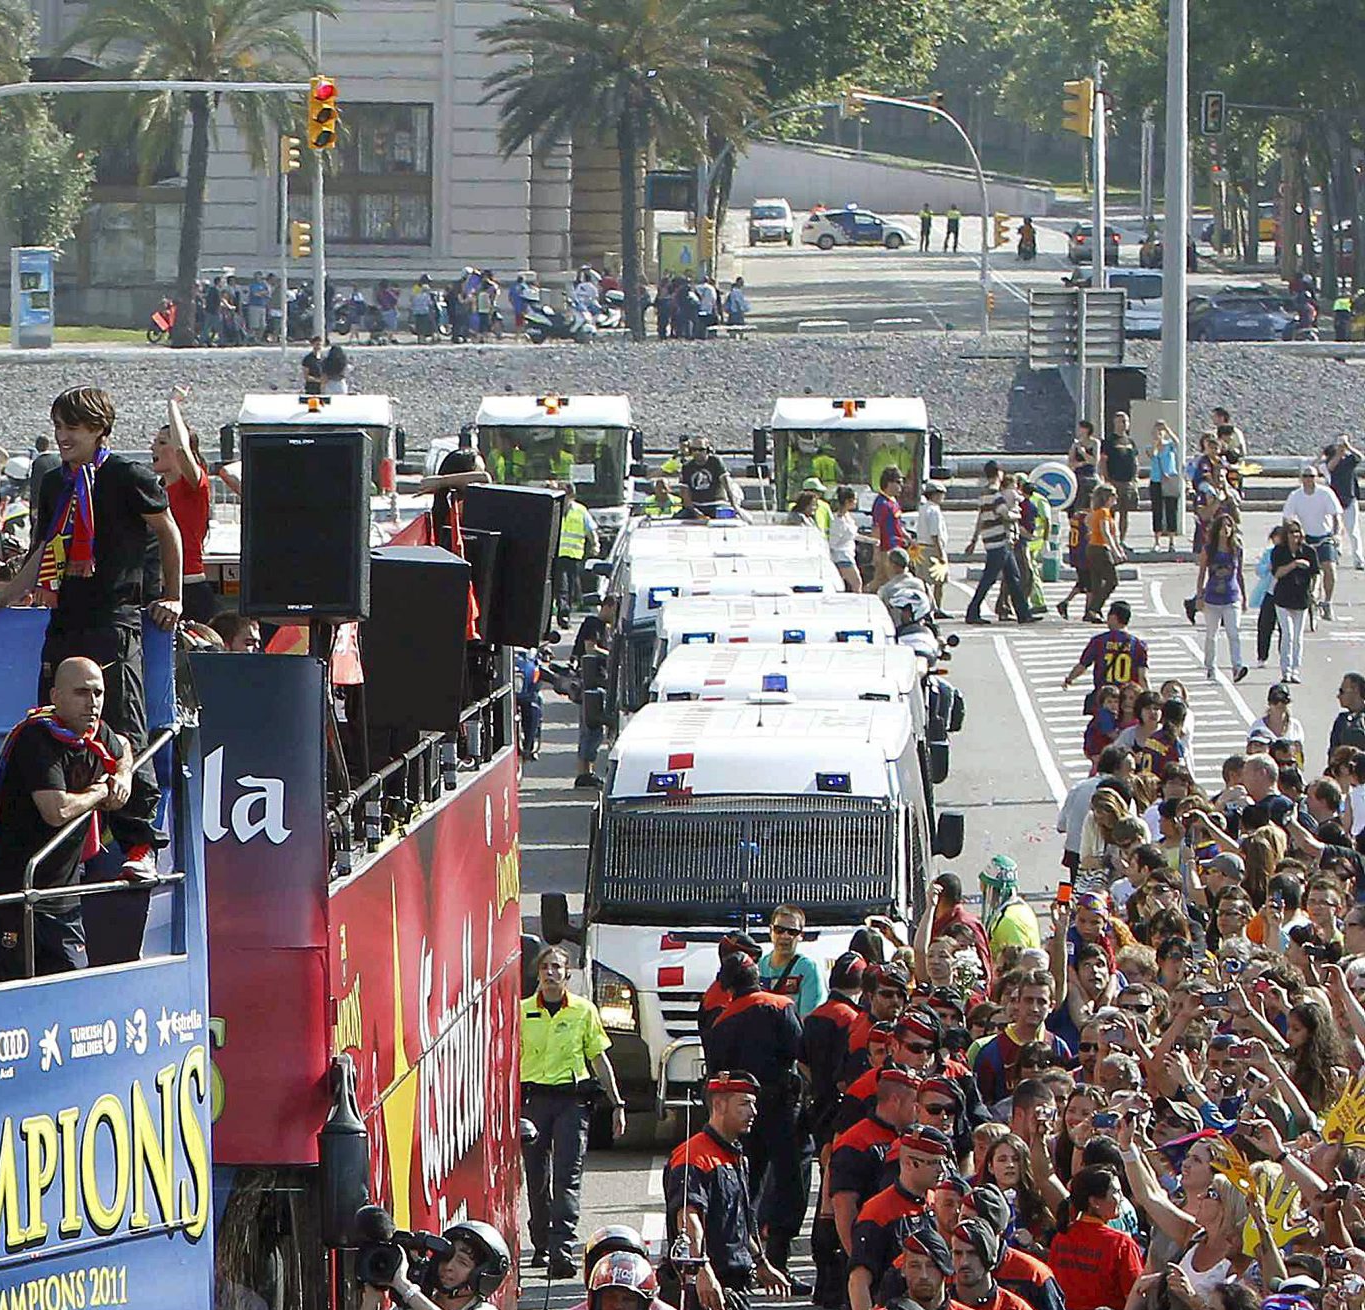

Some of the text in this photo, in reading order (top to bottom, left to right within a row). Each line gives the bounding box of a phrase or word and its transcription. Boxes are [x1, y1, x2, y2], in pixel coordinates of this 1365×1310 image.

[1104, 653, 1132, 683] 10
[203, 745, 292, 844] la
[70, 1024, 103, 1042] TURKISH
[89, 1264, 128, 1308] 2011
